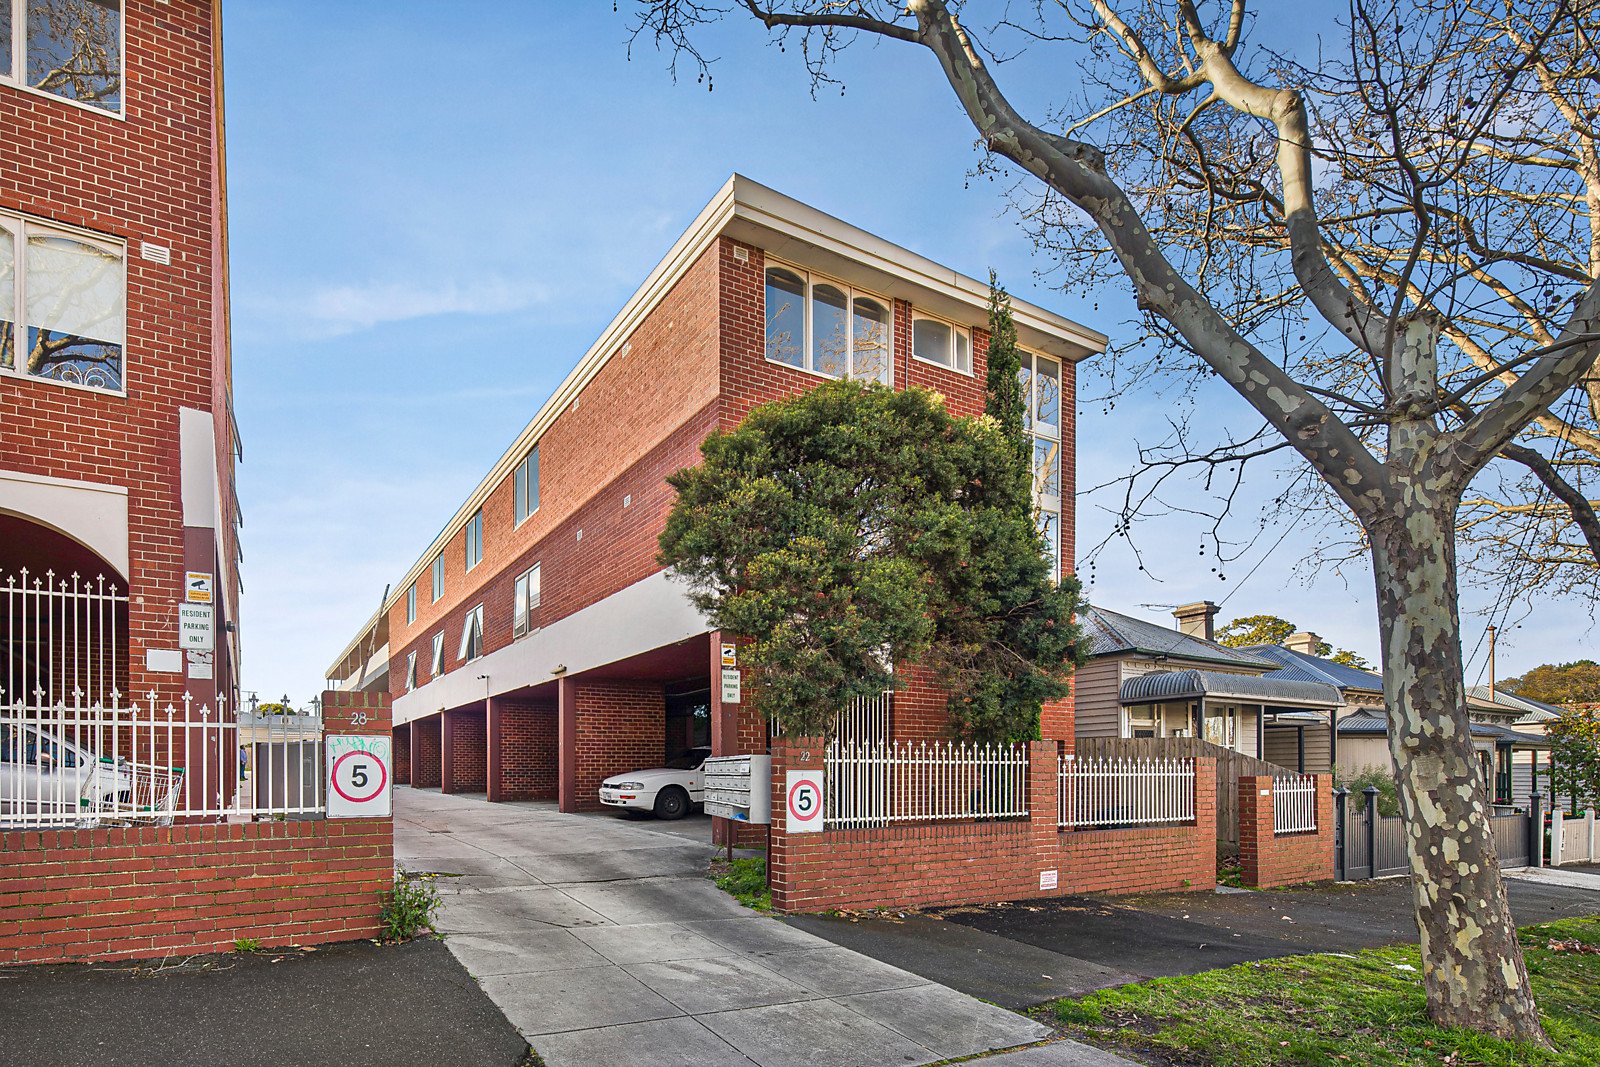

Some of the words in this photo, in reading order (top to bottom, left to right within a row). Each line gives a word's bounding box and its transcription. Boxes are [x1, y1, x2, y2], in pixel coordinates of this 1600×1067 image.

[181, 609, 211, 618] RESIDENT
[183, 622, 210, 631] PARKING
[189, 635, 204, 643] ONLY
[351, 712, 367, 725] 28
[800, 751, 811, 762] 22
[351, 765, 368, 787] 5
[799, 789, 811, 811] 5
